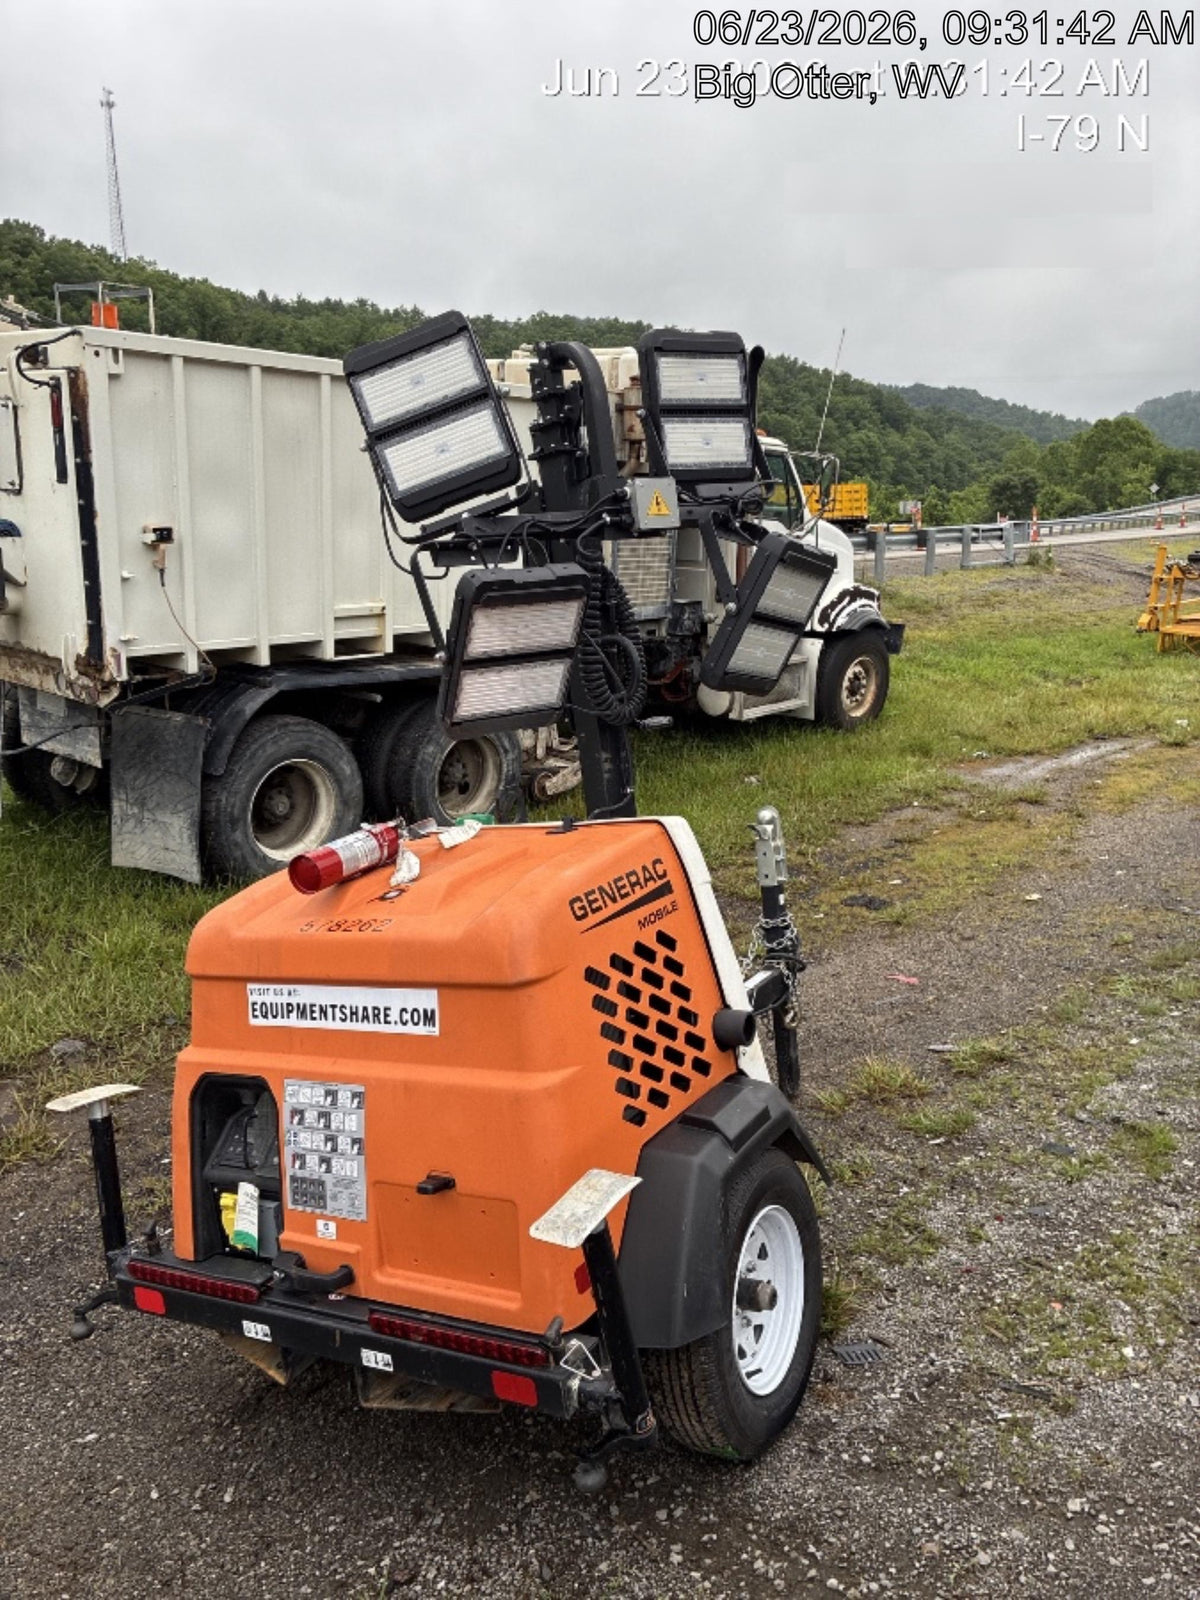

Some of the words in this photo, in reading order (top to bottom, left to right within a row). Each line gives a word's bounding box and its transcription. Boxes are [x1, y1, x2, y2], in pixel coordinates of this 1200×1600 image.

[568, 858, 668, 921] GENERAC
[637, 900, 679, 931] MOBILE
[251, 1001, 436, 1028] EQUIPMENTSHARE.COM
